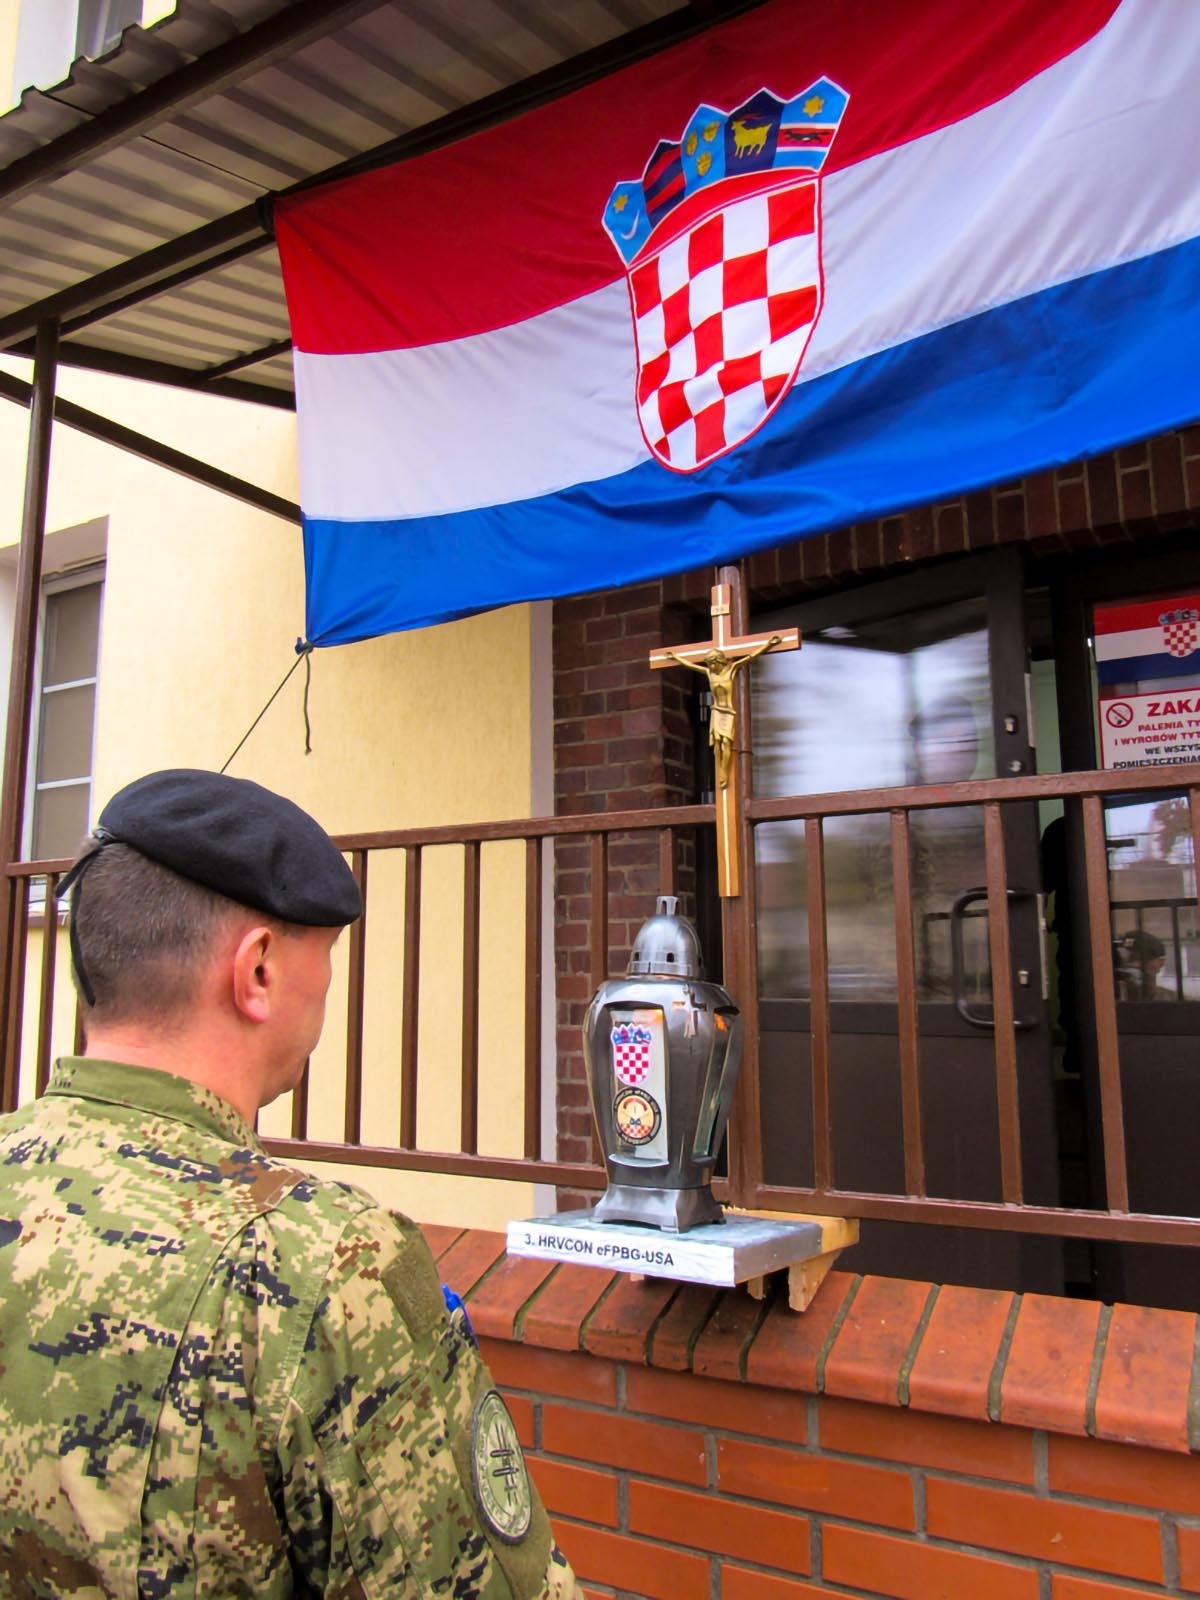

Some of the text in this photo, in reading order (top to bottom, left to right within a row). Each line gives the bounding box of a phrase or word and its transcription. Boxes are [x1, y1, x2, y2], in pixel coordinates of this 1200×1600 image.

[1138, 720, 1184, 732] PALENIA
[1121, 732, 1177, 745] WYROBÓW
[1144, 746, 1161, 755] WE
[1113, 755, 1200, 769] POMIESZCZENIA
[524, 1233, 674, 1266] 3. HRVCON eFPBG-USA
